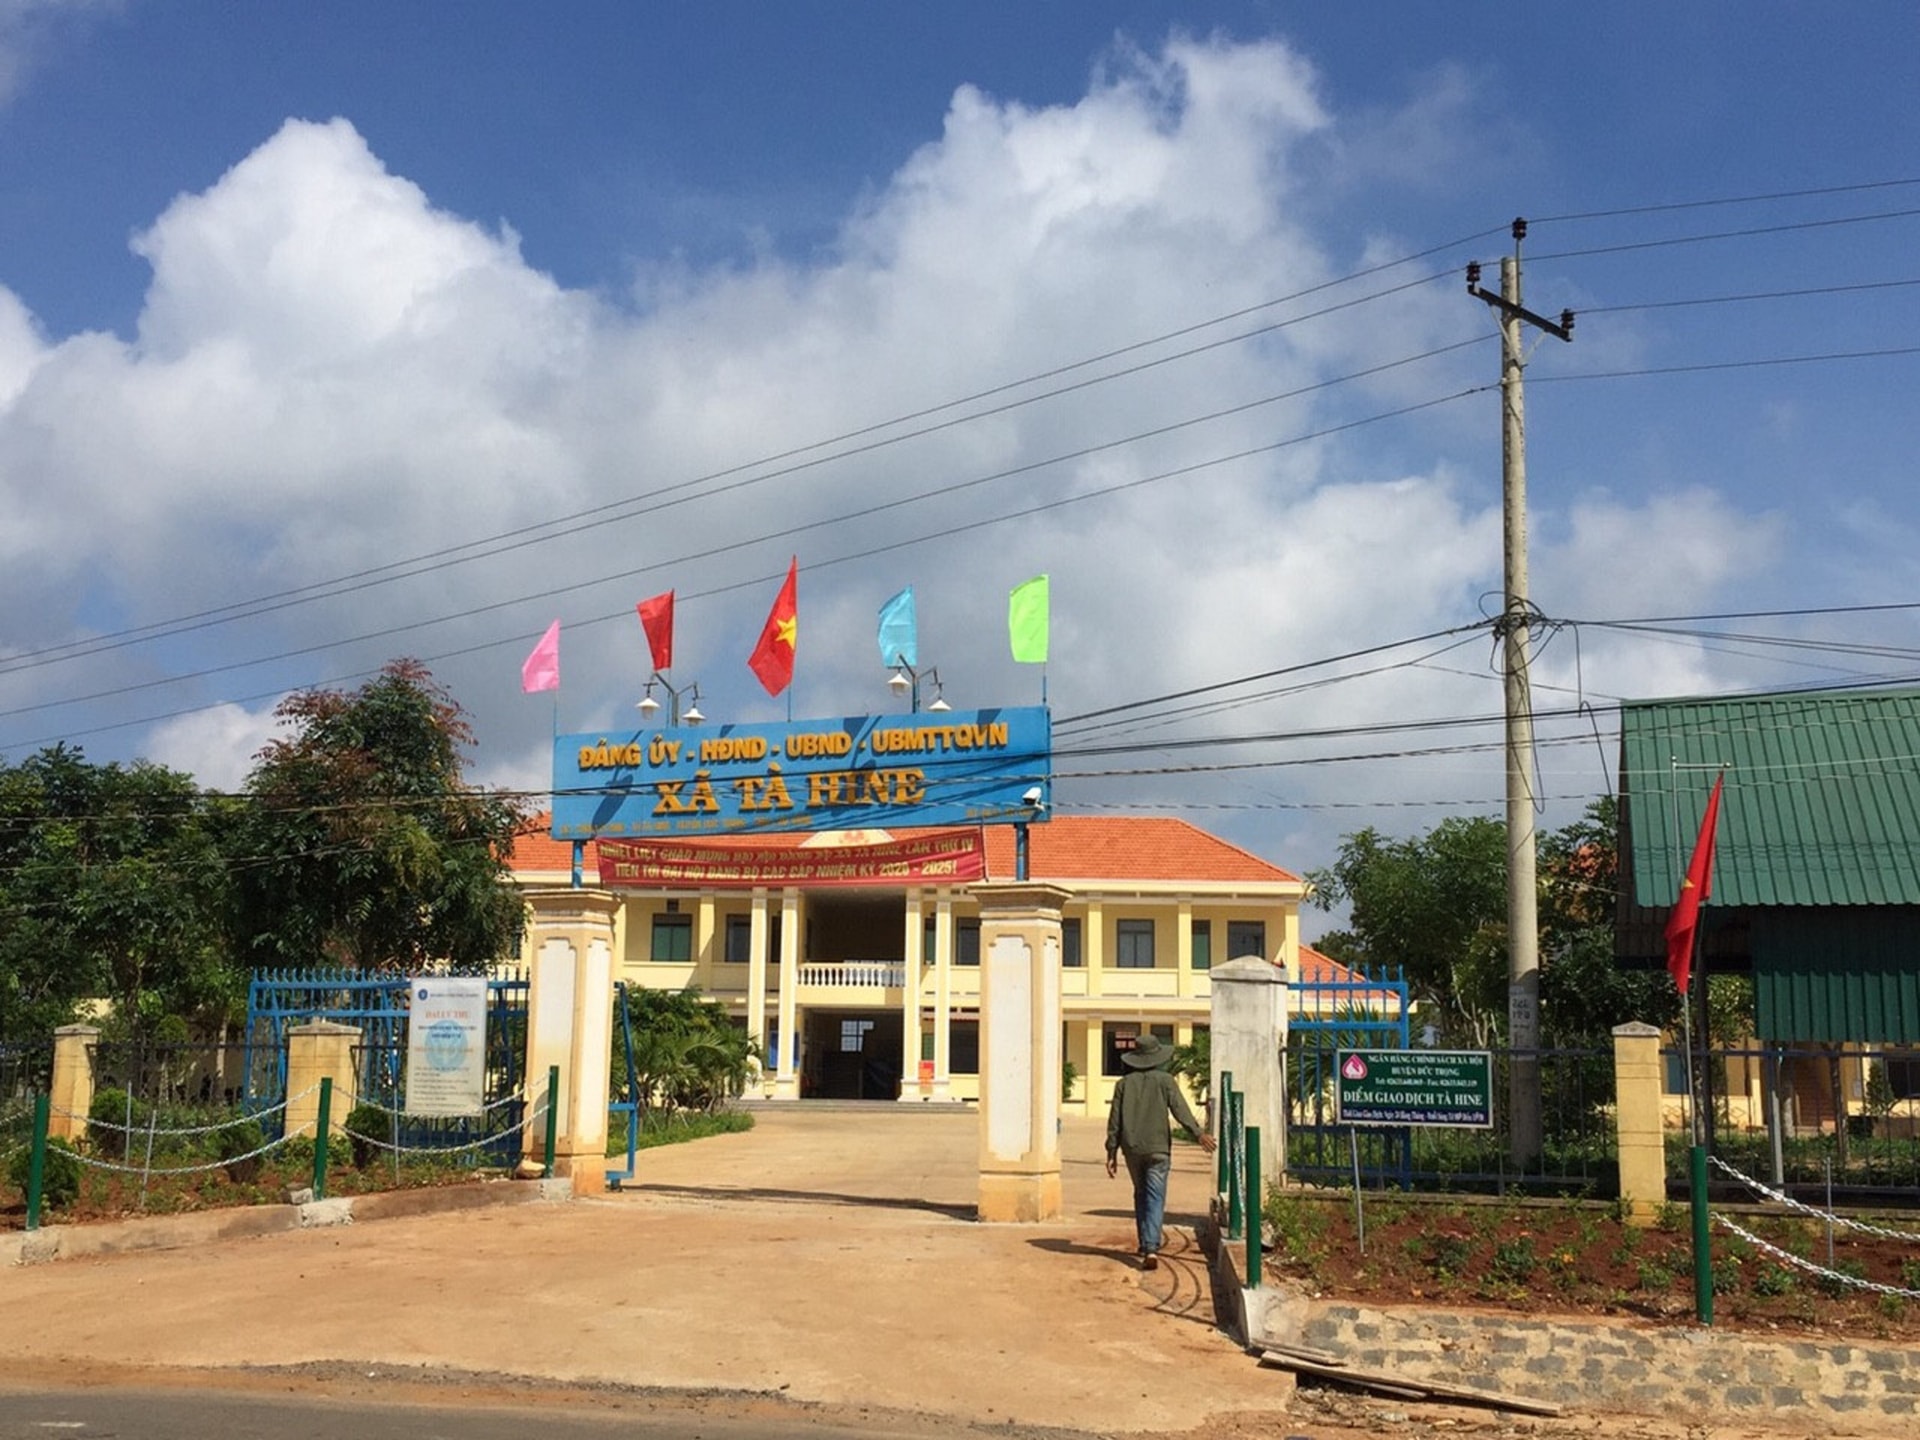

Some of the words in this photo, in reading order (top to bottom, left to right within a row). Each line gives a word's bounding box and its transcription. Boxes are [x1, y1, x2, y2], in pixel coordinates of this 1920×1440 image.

[579, 737, 642, 772] ĐẢNG
[648, 734, 682, 767] ỦY
[700, 736, 767, 766] HĐND
[787, 731, 852, 759] UBND
[872, 722, 1010, 756] UBMTTQVN
[652, 769, 721, 817] XÃ
[735, 761, 795, 812] TÀ
[807, 768, 927, 808] HINE
[879, 861, 910, 877] 2020
[1343, 1086, 1373, 1103] ĐIỂM
[1374, 1091, 1404, 1104] GIAO
[1405, 1091, 1435, 1106] DỊCH
[1436, 1090, 1452, 1105] TÀ
[1454, 1093, 1483, 1106] HINE
